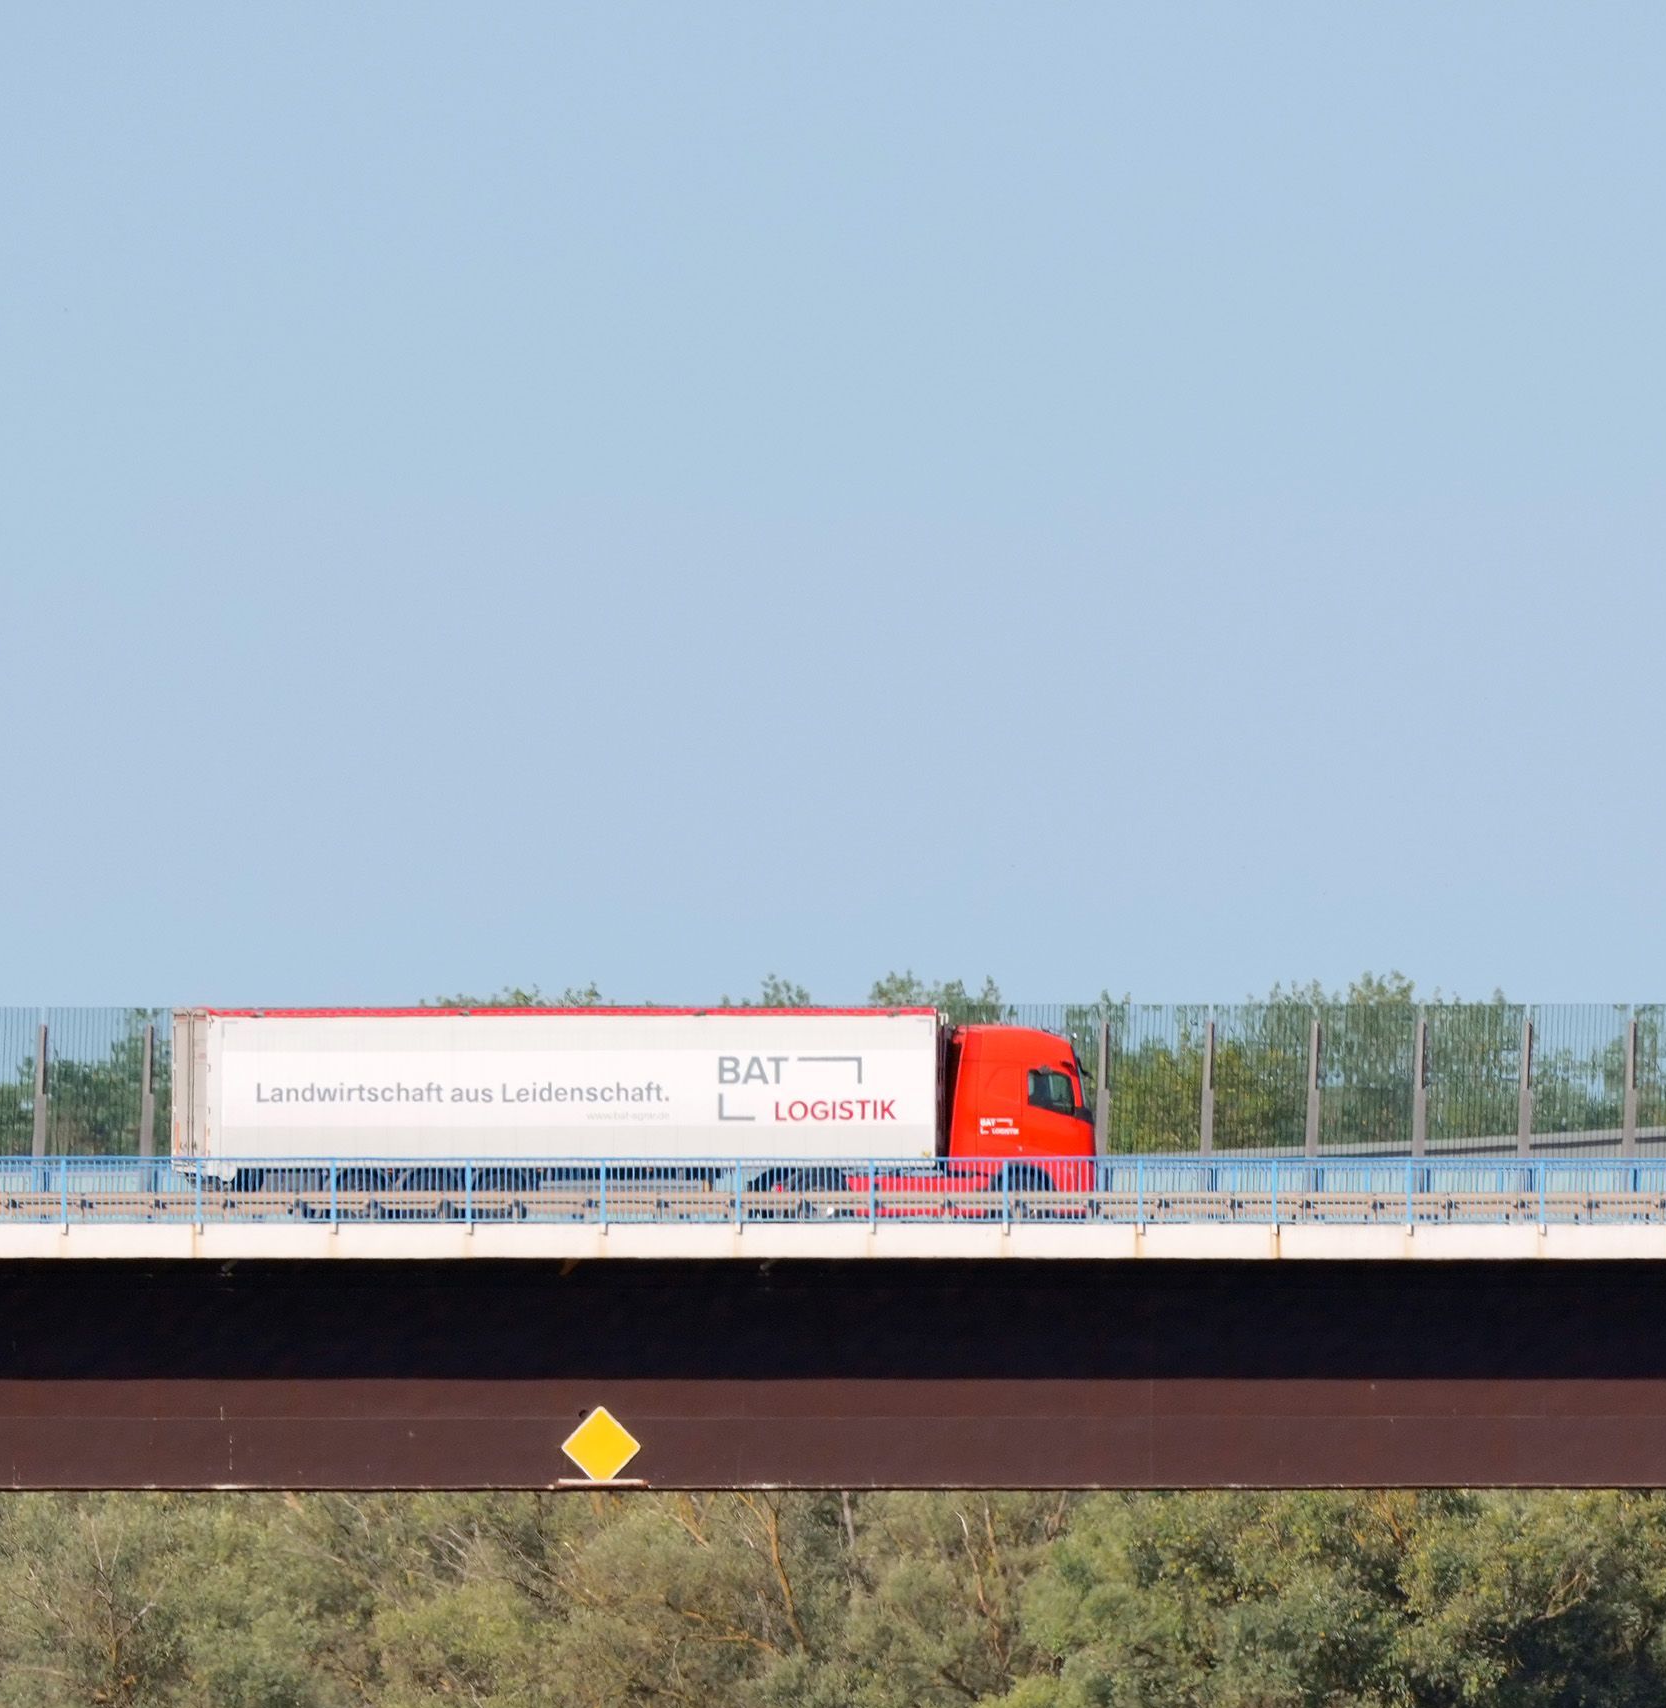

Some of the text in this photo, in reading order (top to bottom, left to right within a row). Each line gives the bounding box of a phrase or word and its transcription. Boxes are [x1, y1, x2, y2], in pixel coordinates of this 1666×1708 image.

[718, 1056, 789, 1085] BAT
[256, 1082, 670, 1103] Landwirtschaft aus Leidenschaft.
[775, 1099, 897, 1122] LOGISTIK
